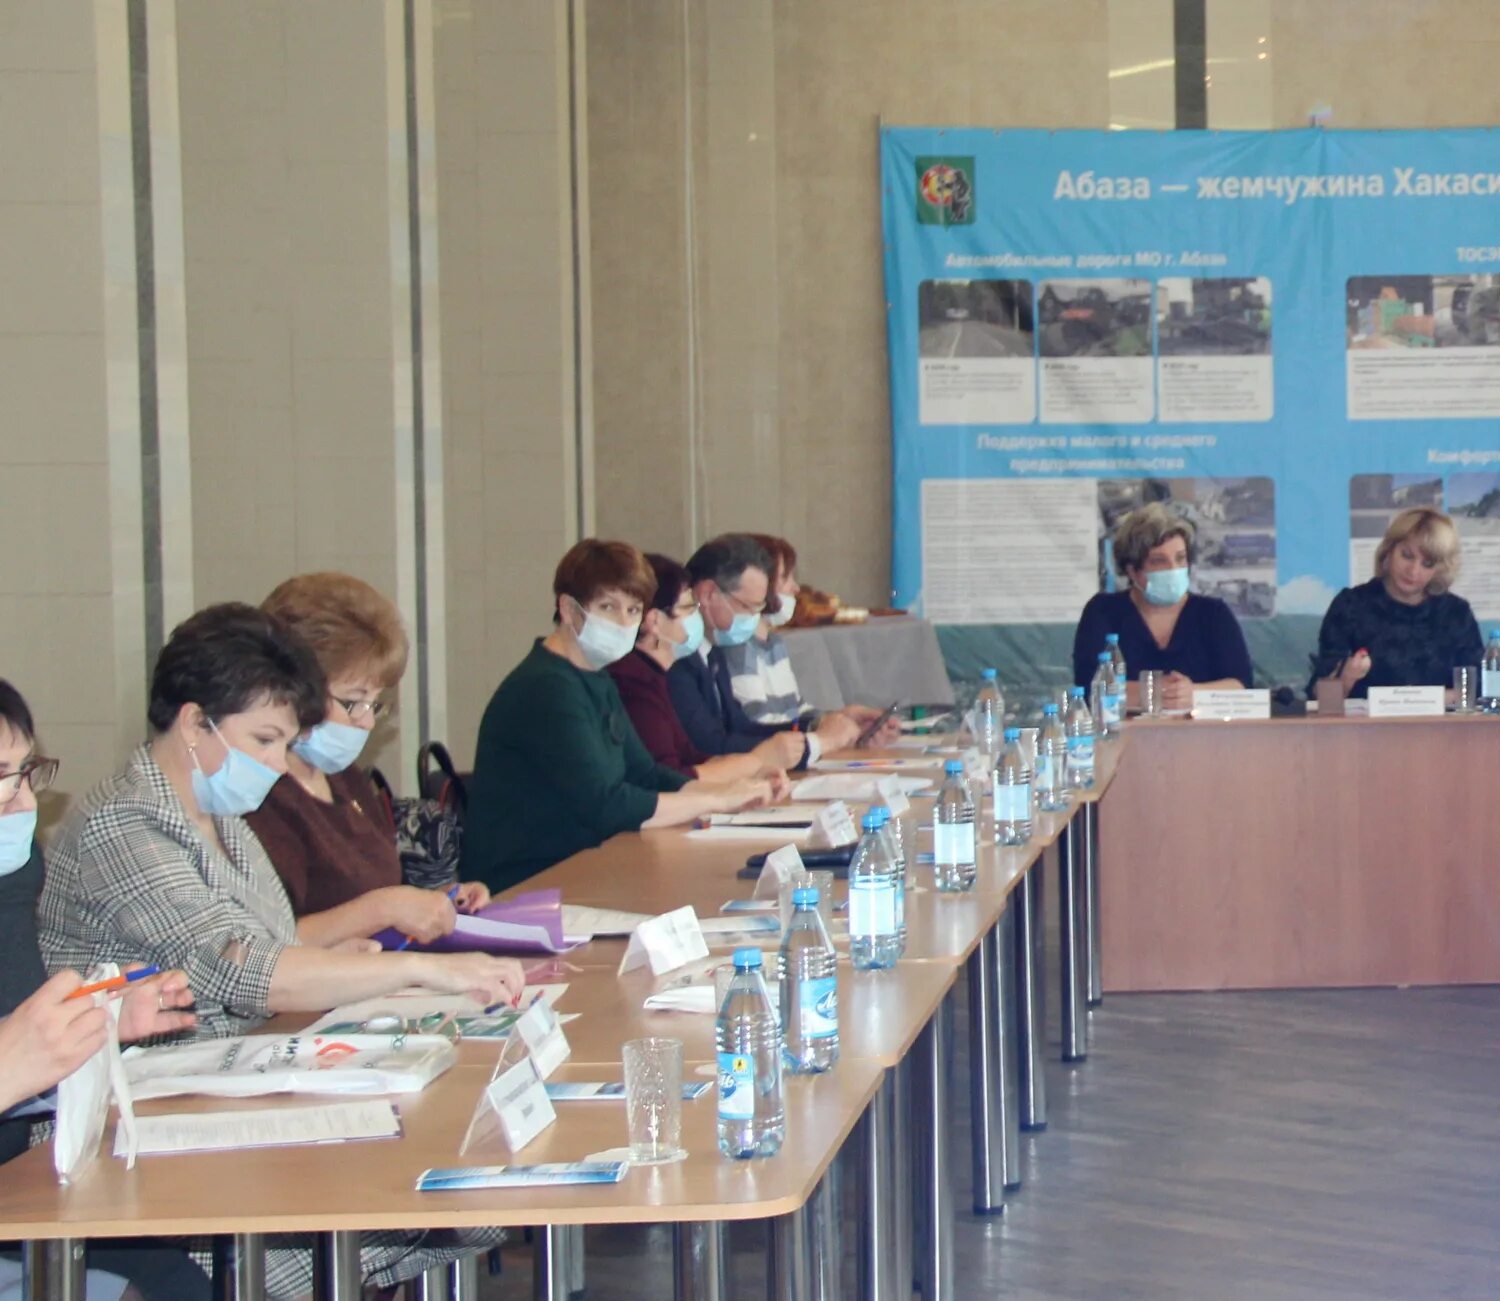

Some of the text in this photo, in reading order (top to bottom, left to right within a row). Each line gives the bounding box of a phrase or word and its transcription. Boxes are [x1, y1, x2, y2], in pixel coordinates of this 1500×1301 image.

[1053, 169, 1151, 201] Абаза
[1196, 173, 1385, 206] жемчужина
[945, 253, 1073, 269] Автомобильные
[1076, 254, 1133, 269] дороги
[1135, 251, 1162, 266] МО
[977, 433, 1217, 450] Поддержка малого и среднего
[1010, 457, 1185, 472] предпринимательства
